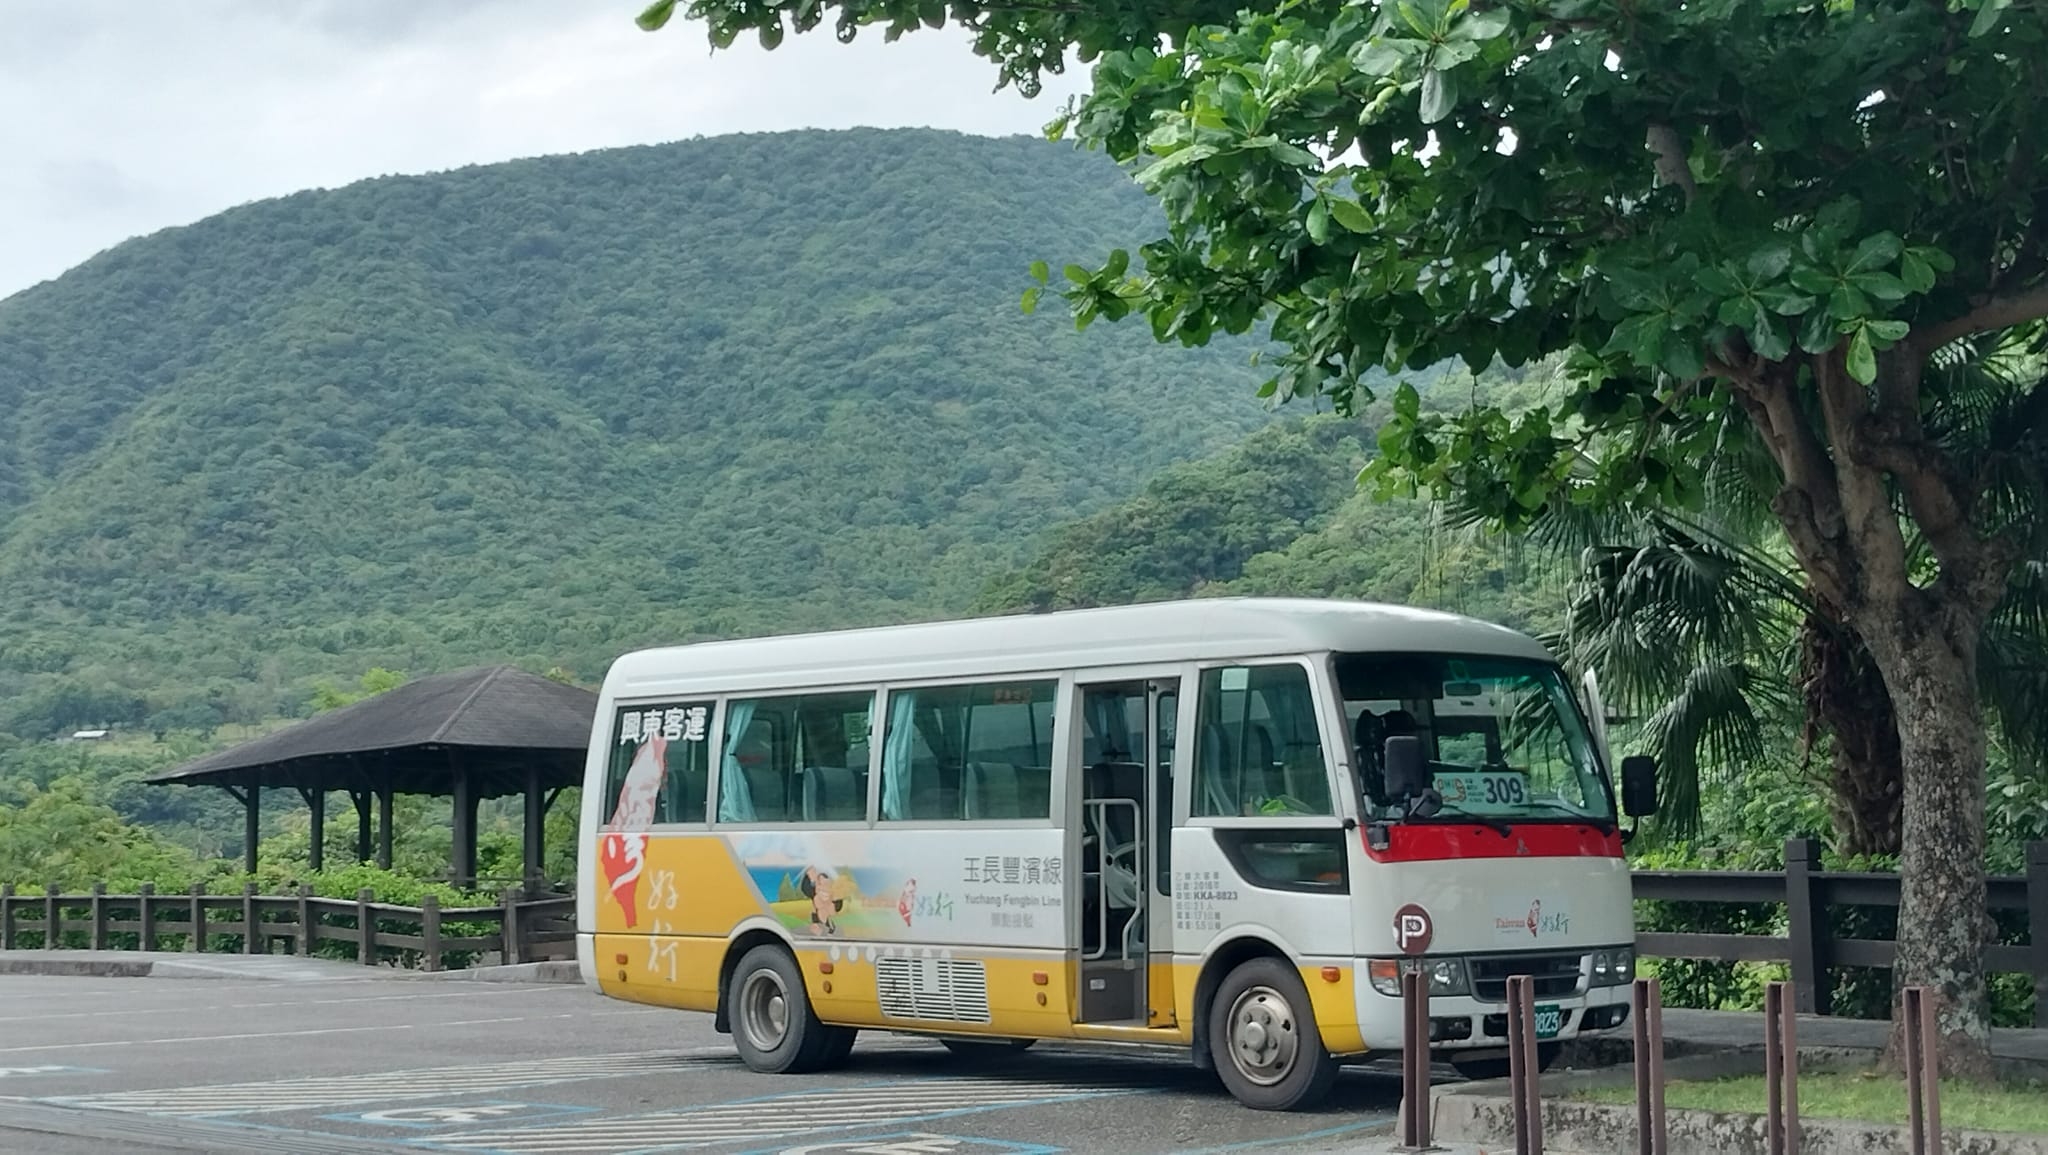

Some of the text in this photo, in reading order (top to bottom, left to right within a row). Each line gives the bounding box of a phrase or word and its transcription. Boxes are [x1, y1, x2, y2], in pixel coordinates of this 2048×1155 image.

[620, 707, 707, 746] 興東客運
[1482, 776, 1524, 804] 309
[963, 856, 1062, 885] 玉長豐濱線
[964, 893, 1062, 909] Yuchang Fengbin Line
[1401, 914, 1427, 949] P
